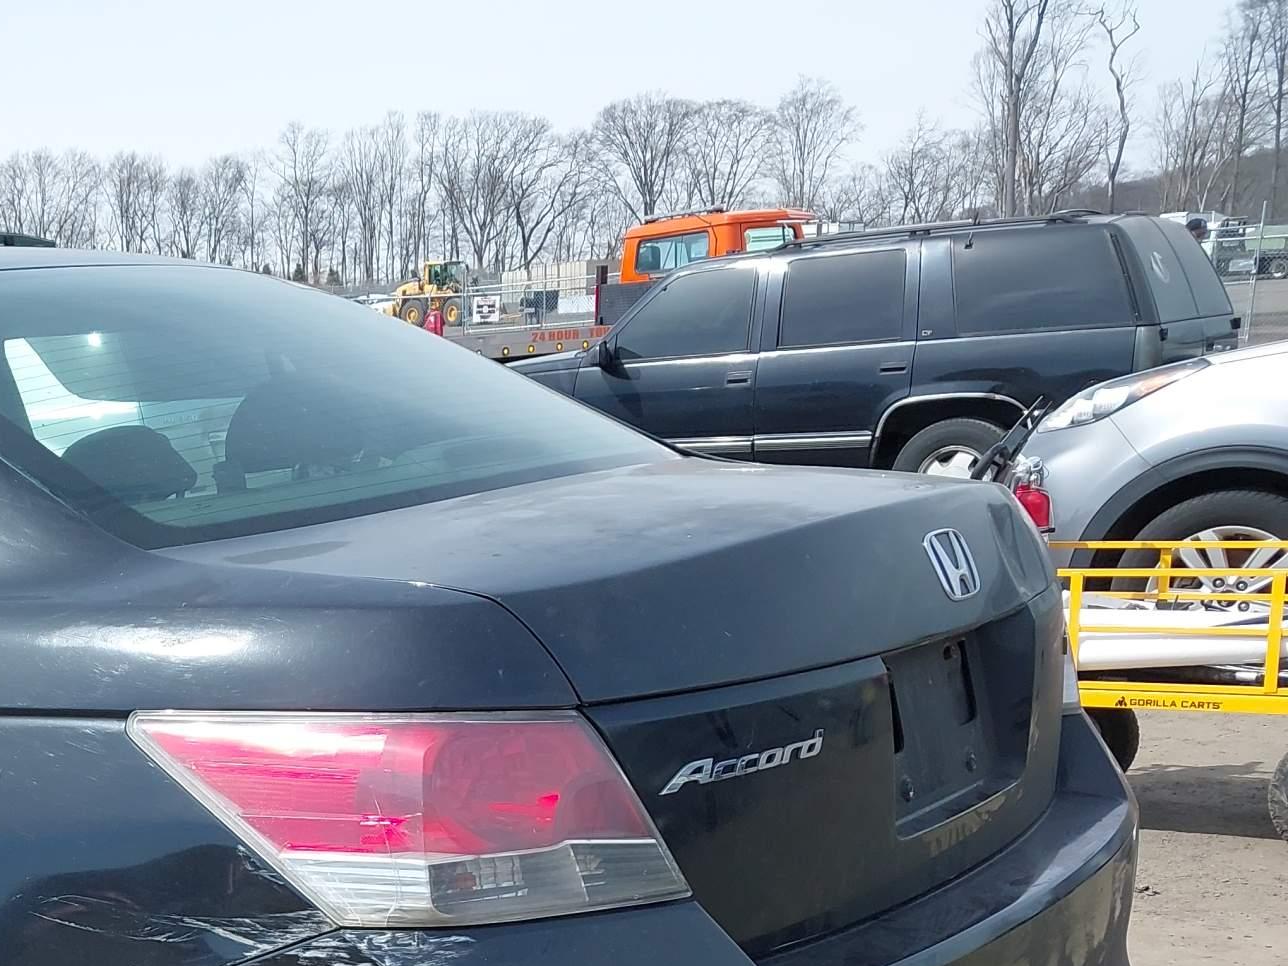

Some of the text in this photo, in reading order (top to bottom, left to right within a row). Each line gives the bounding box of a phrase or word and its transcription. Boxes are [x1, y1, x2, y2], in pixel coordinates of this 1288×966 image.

[531, 332, 546, 343] 24
[548, 329, 580, 341] HOUR
[1129, 698, 1221, 710] GORILLA CARTS
[657, 728, 825, 796] Accord
